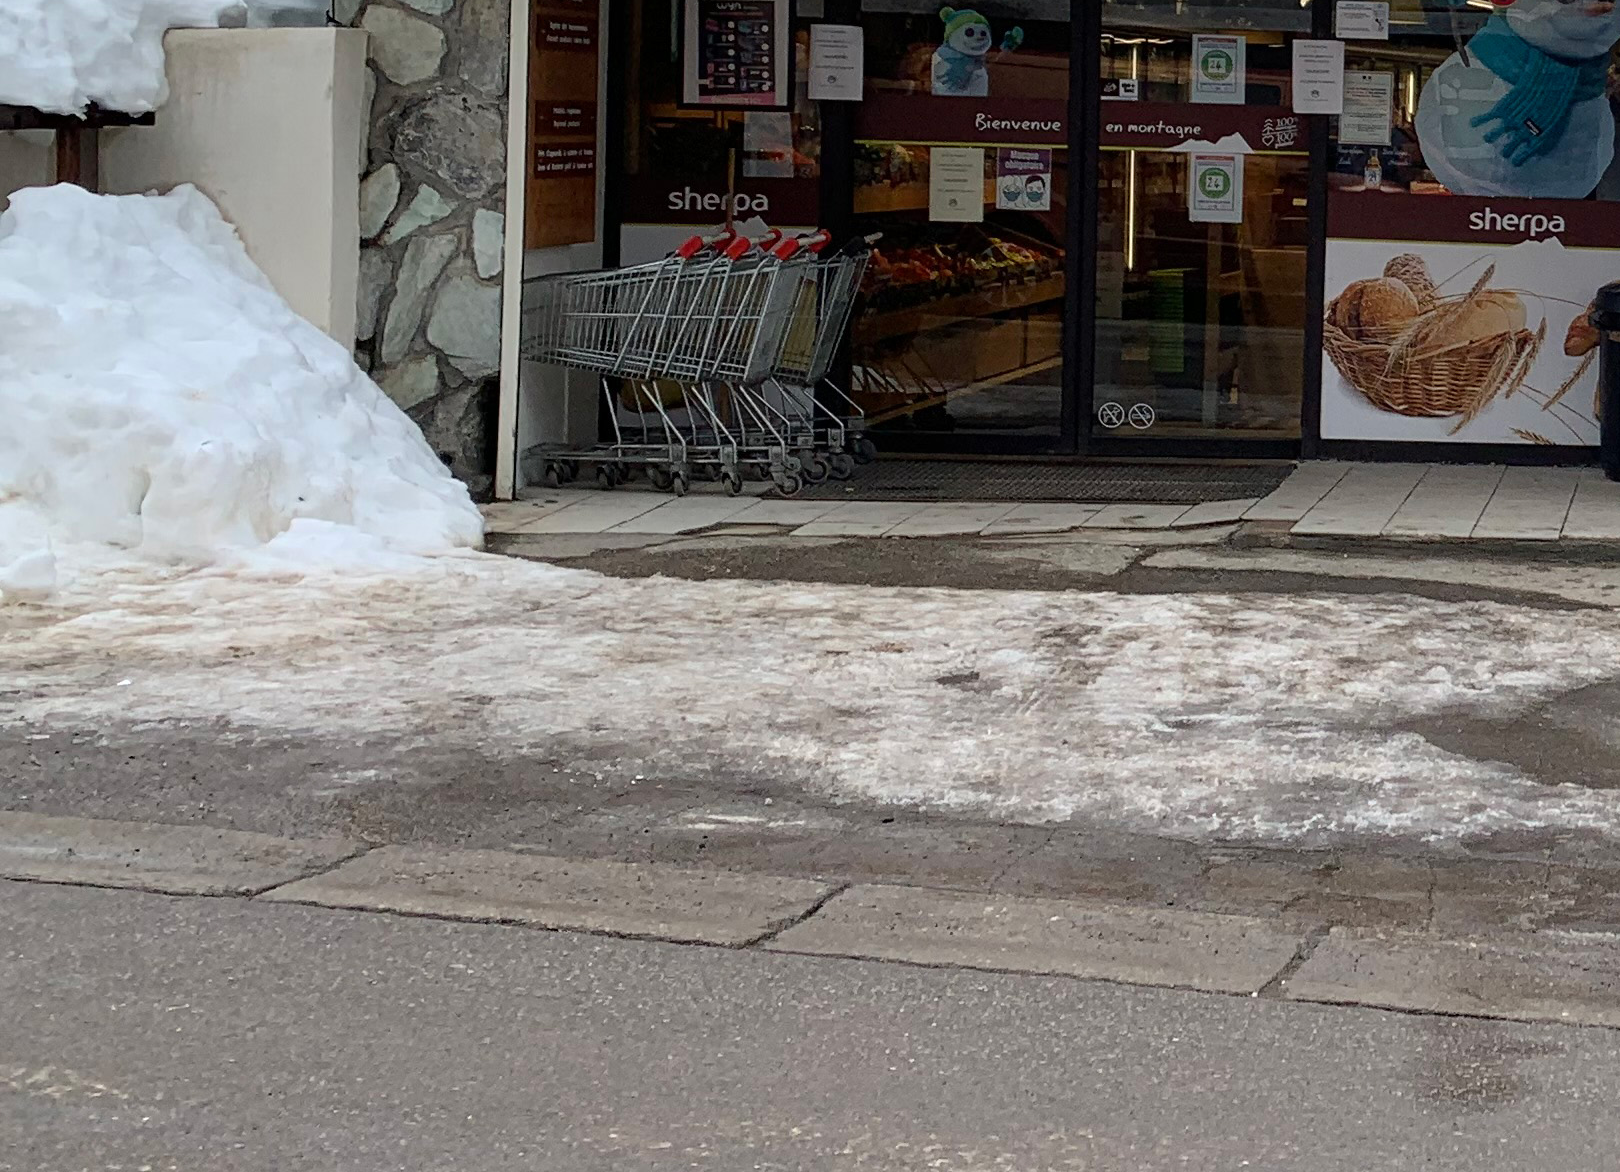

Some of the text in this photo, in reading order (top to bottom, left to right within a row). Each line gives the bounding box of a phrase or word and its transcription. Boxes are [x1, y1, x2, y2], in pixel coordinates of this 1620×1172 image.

[975, 112, 1202, 139] Bienvenue en montagne
[668, 185, 770, 216] sherpa
[1468, 207, 1565, 240] sherpa
